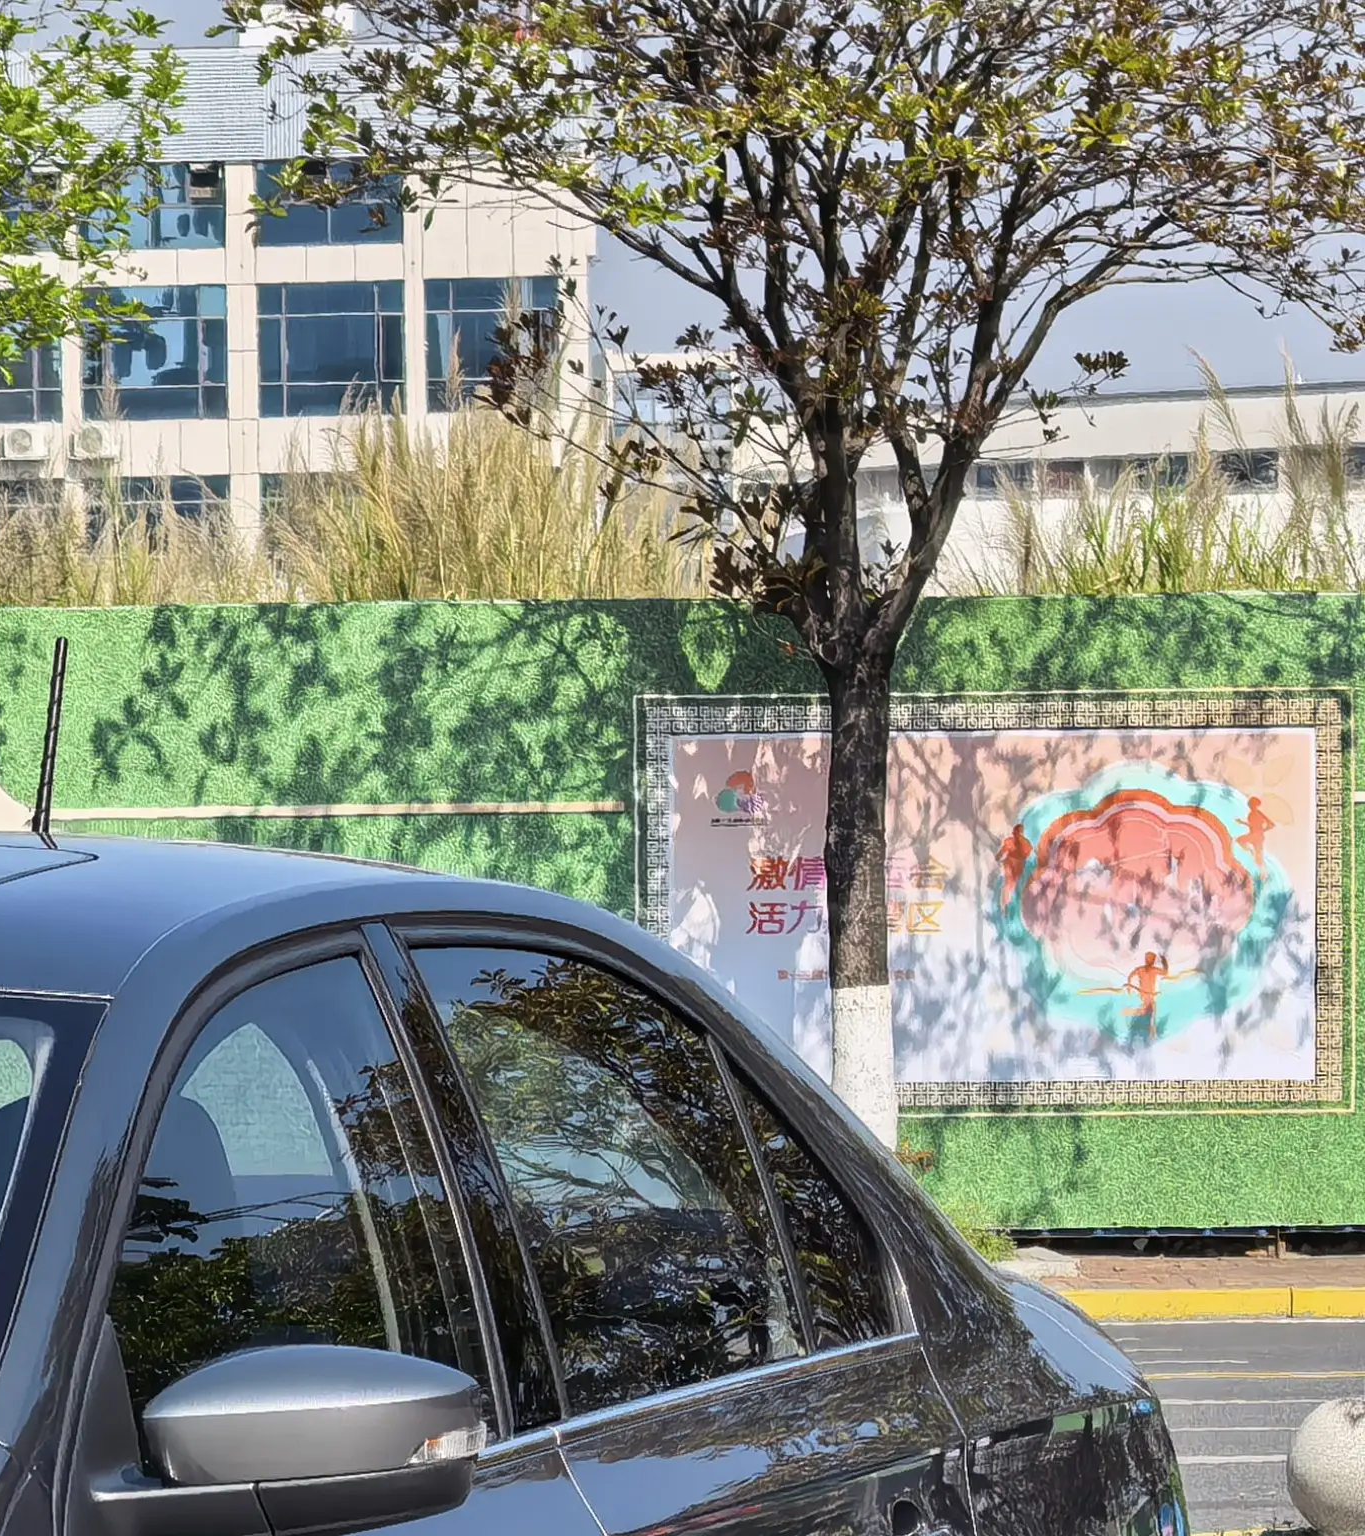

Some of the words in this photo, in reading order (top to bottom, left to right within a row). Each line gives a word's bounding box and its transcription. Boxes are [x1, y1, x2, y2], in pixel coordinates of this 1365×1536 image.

[746, 856, 950, 891] 激情会
[746, 900, 945, 935] 活力区
